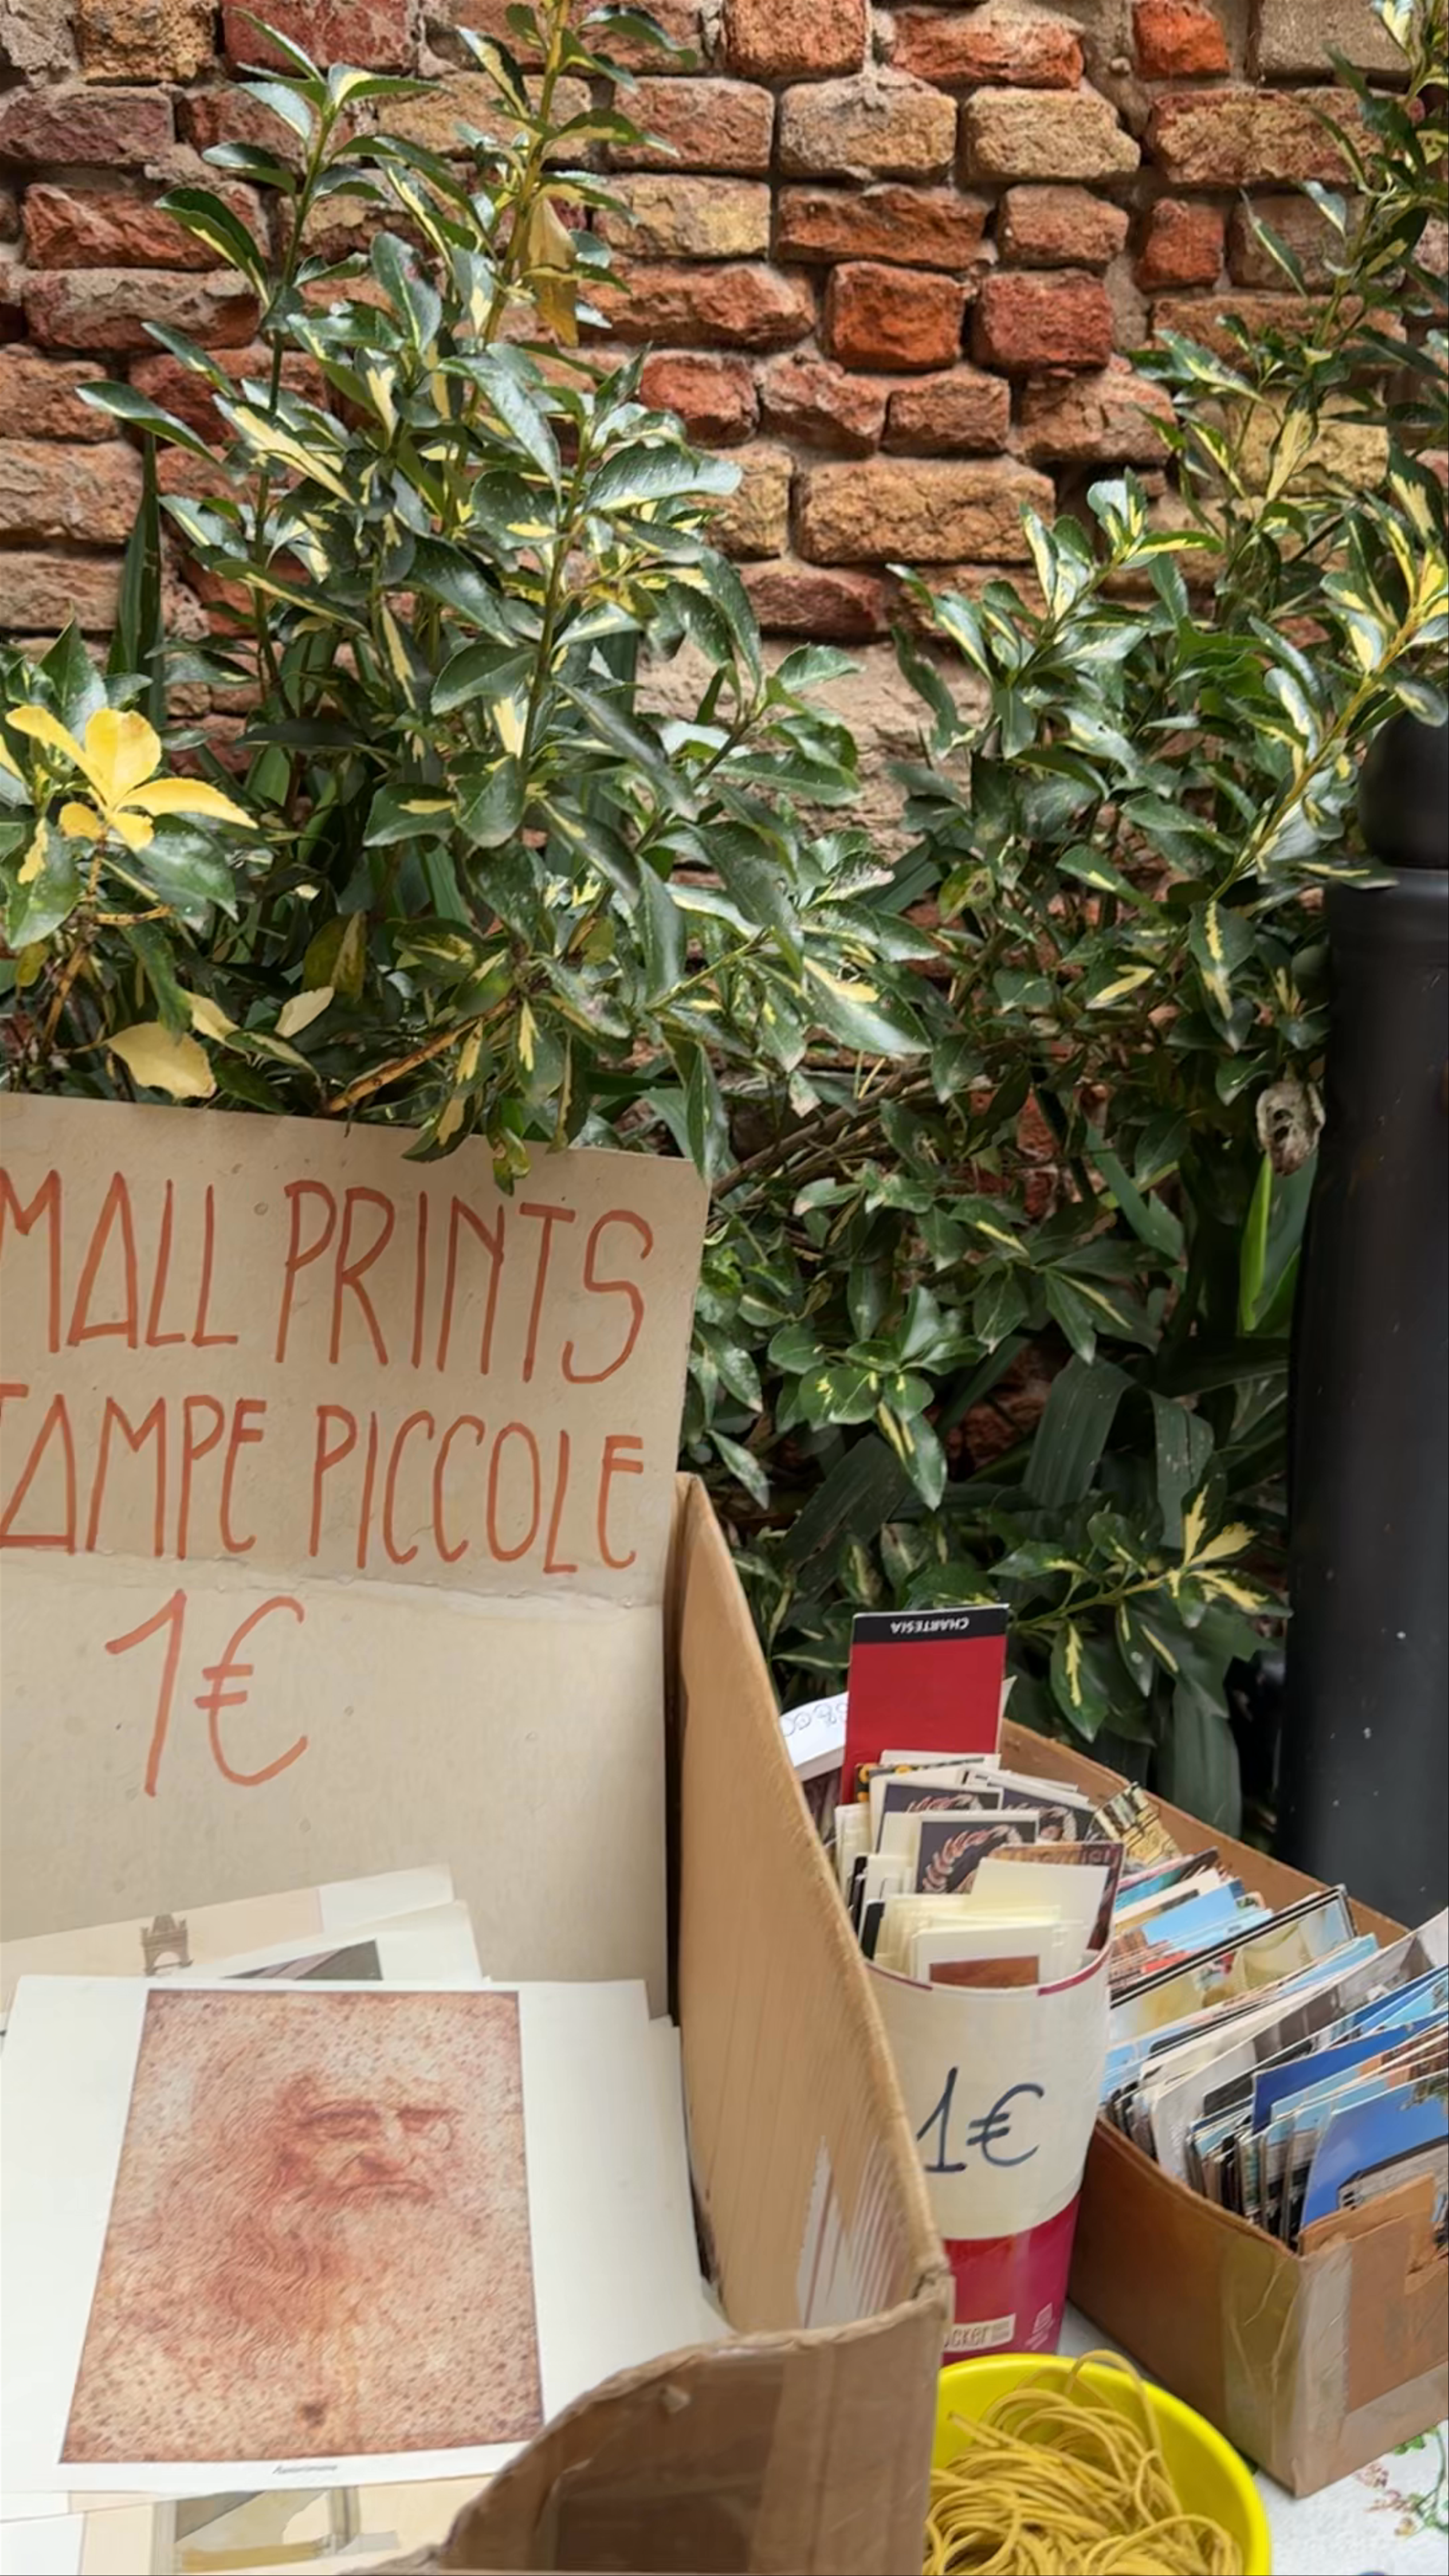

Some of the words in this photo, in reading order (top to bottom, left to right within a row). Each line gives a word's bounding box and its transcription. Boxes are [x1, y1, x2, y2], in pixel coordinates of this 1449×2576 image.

[0, 1167, 238, 1354] MALL
[276, 1178, 655, 1385] PRINTS
[309, 1404, 645, 1575] PICCOLE
[105, 1589, 309, 1797] 1€
[916, 2065, 1045, 2173] 1€
